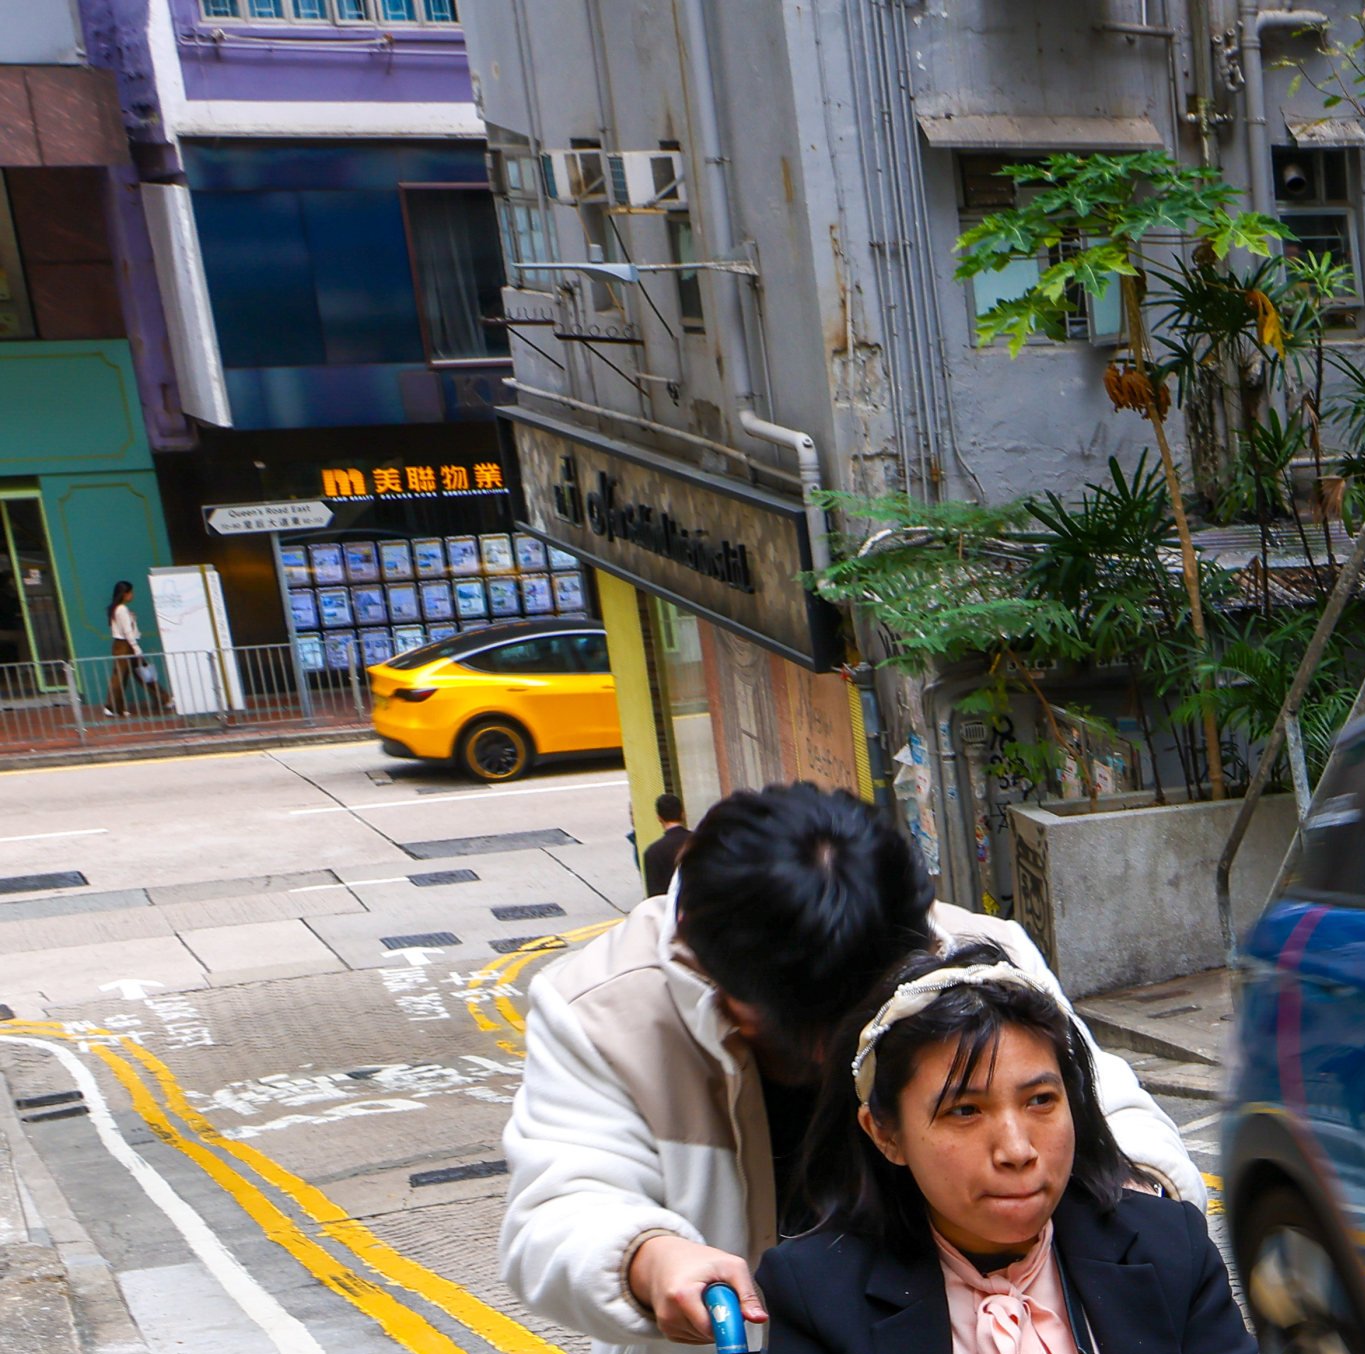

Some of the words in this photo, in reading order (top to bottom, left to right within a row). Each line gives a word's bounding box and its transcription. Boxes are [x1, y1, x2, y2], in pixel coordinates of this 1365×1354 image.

[371, 462, 503, 494] 美聯物業
[264, 506, 289, 515] Road
[290, 504, 312, 514] East
